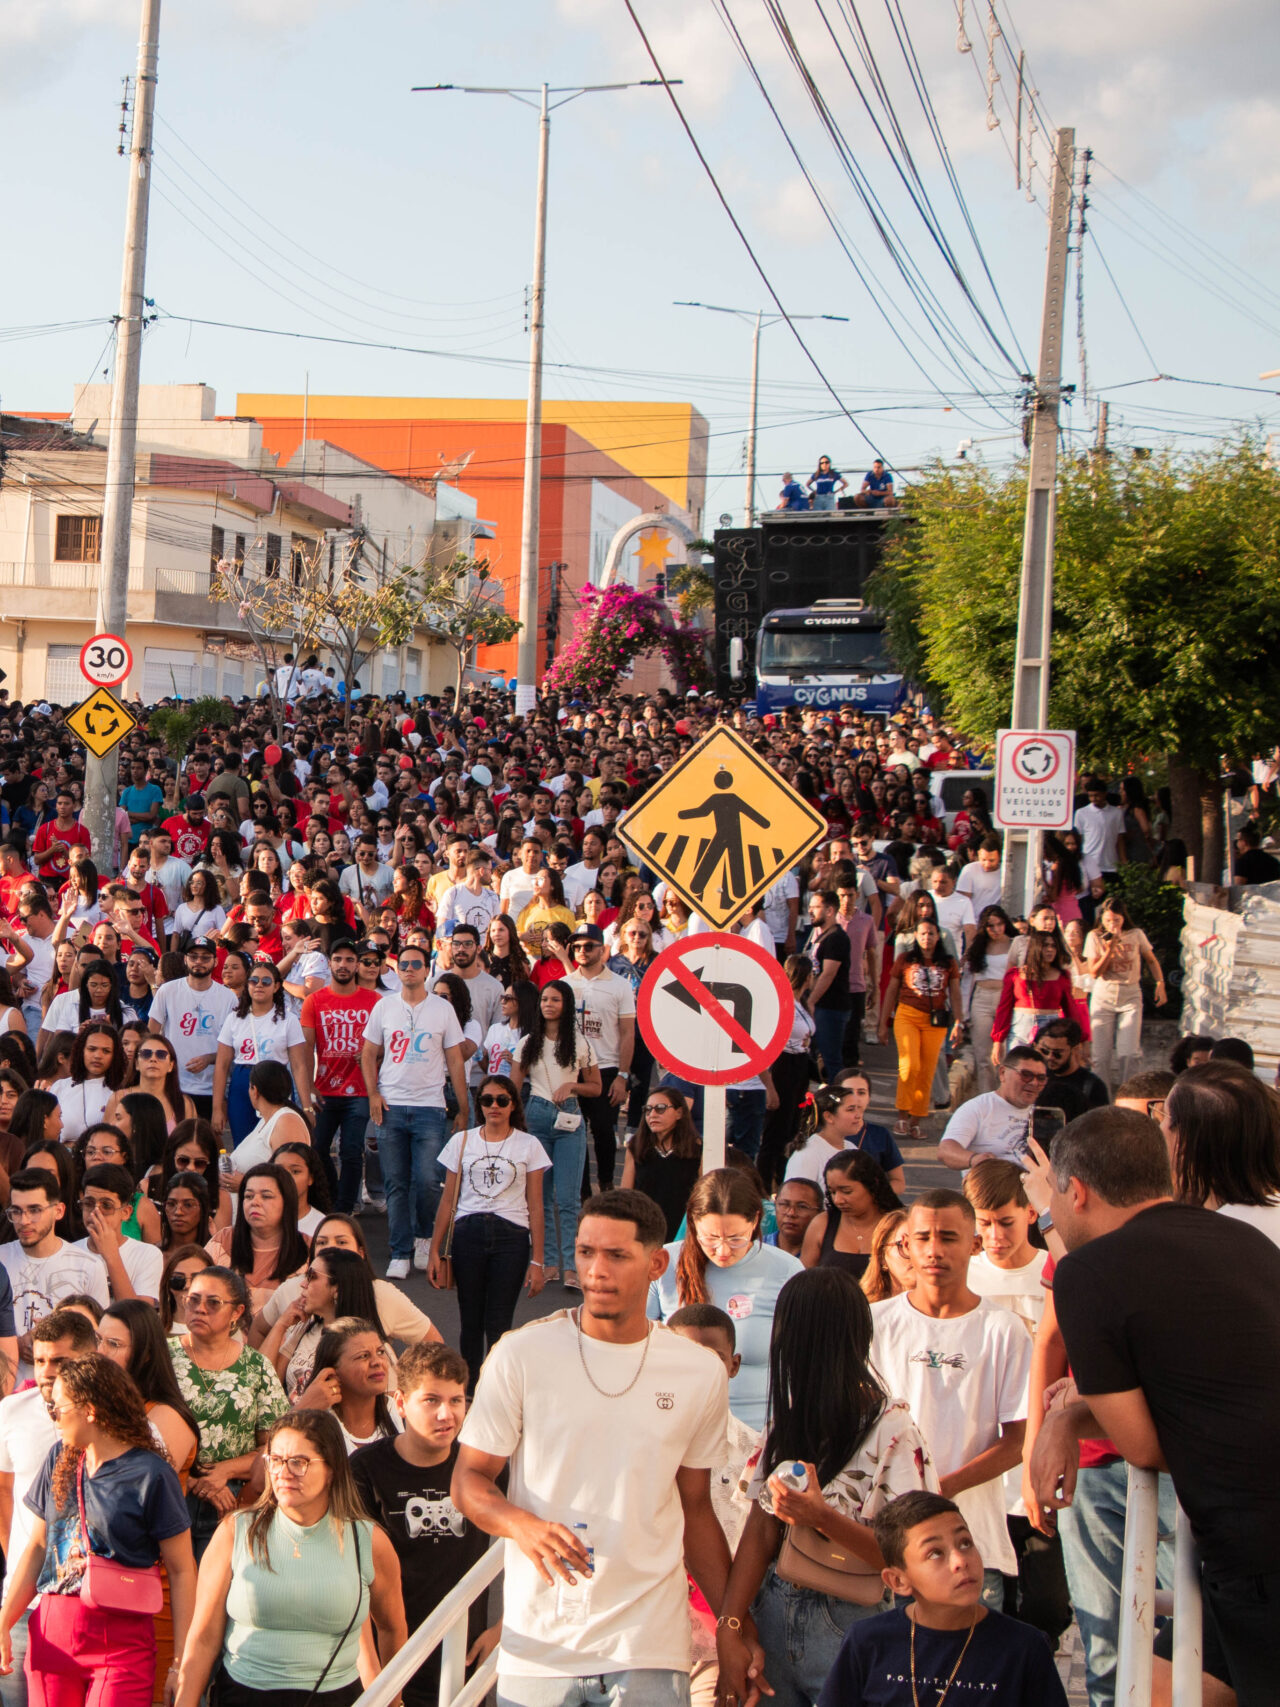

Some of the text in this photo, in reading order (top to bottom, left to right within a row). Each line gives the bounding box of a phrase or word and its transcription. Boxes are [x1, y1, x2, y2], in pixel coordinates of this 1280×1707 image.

[804, 617, 860, 625] CYGNUS
[89, 646, 125, 669] 30
[1002, 787, 1066, 796] EXCLUSIVO
